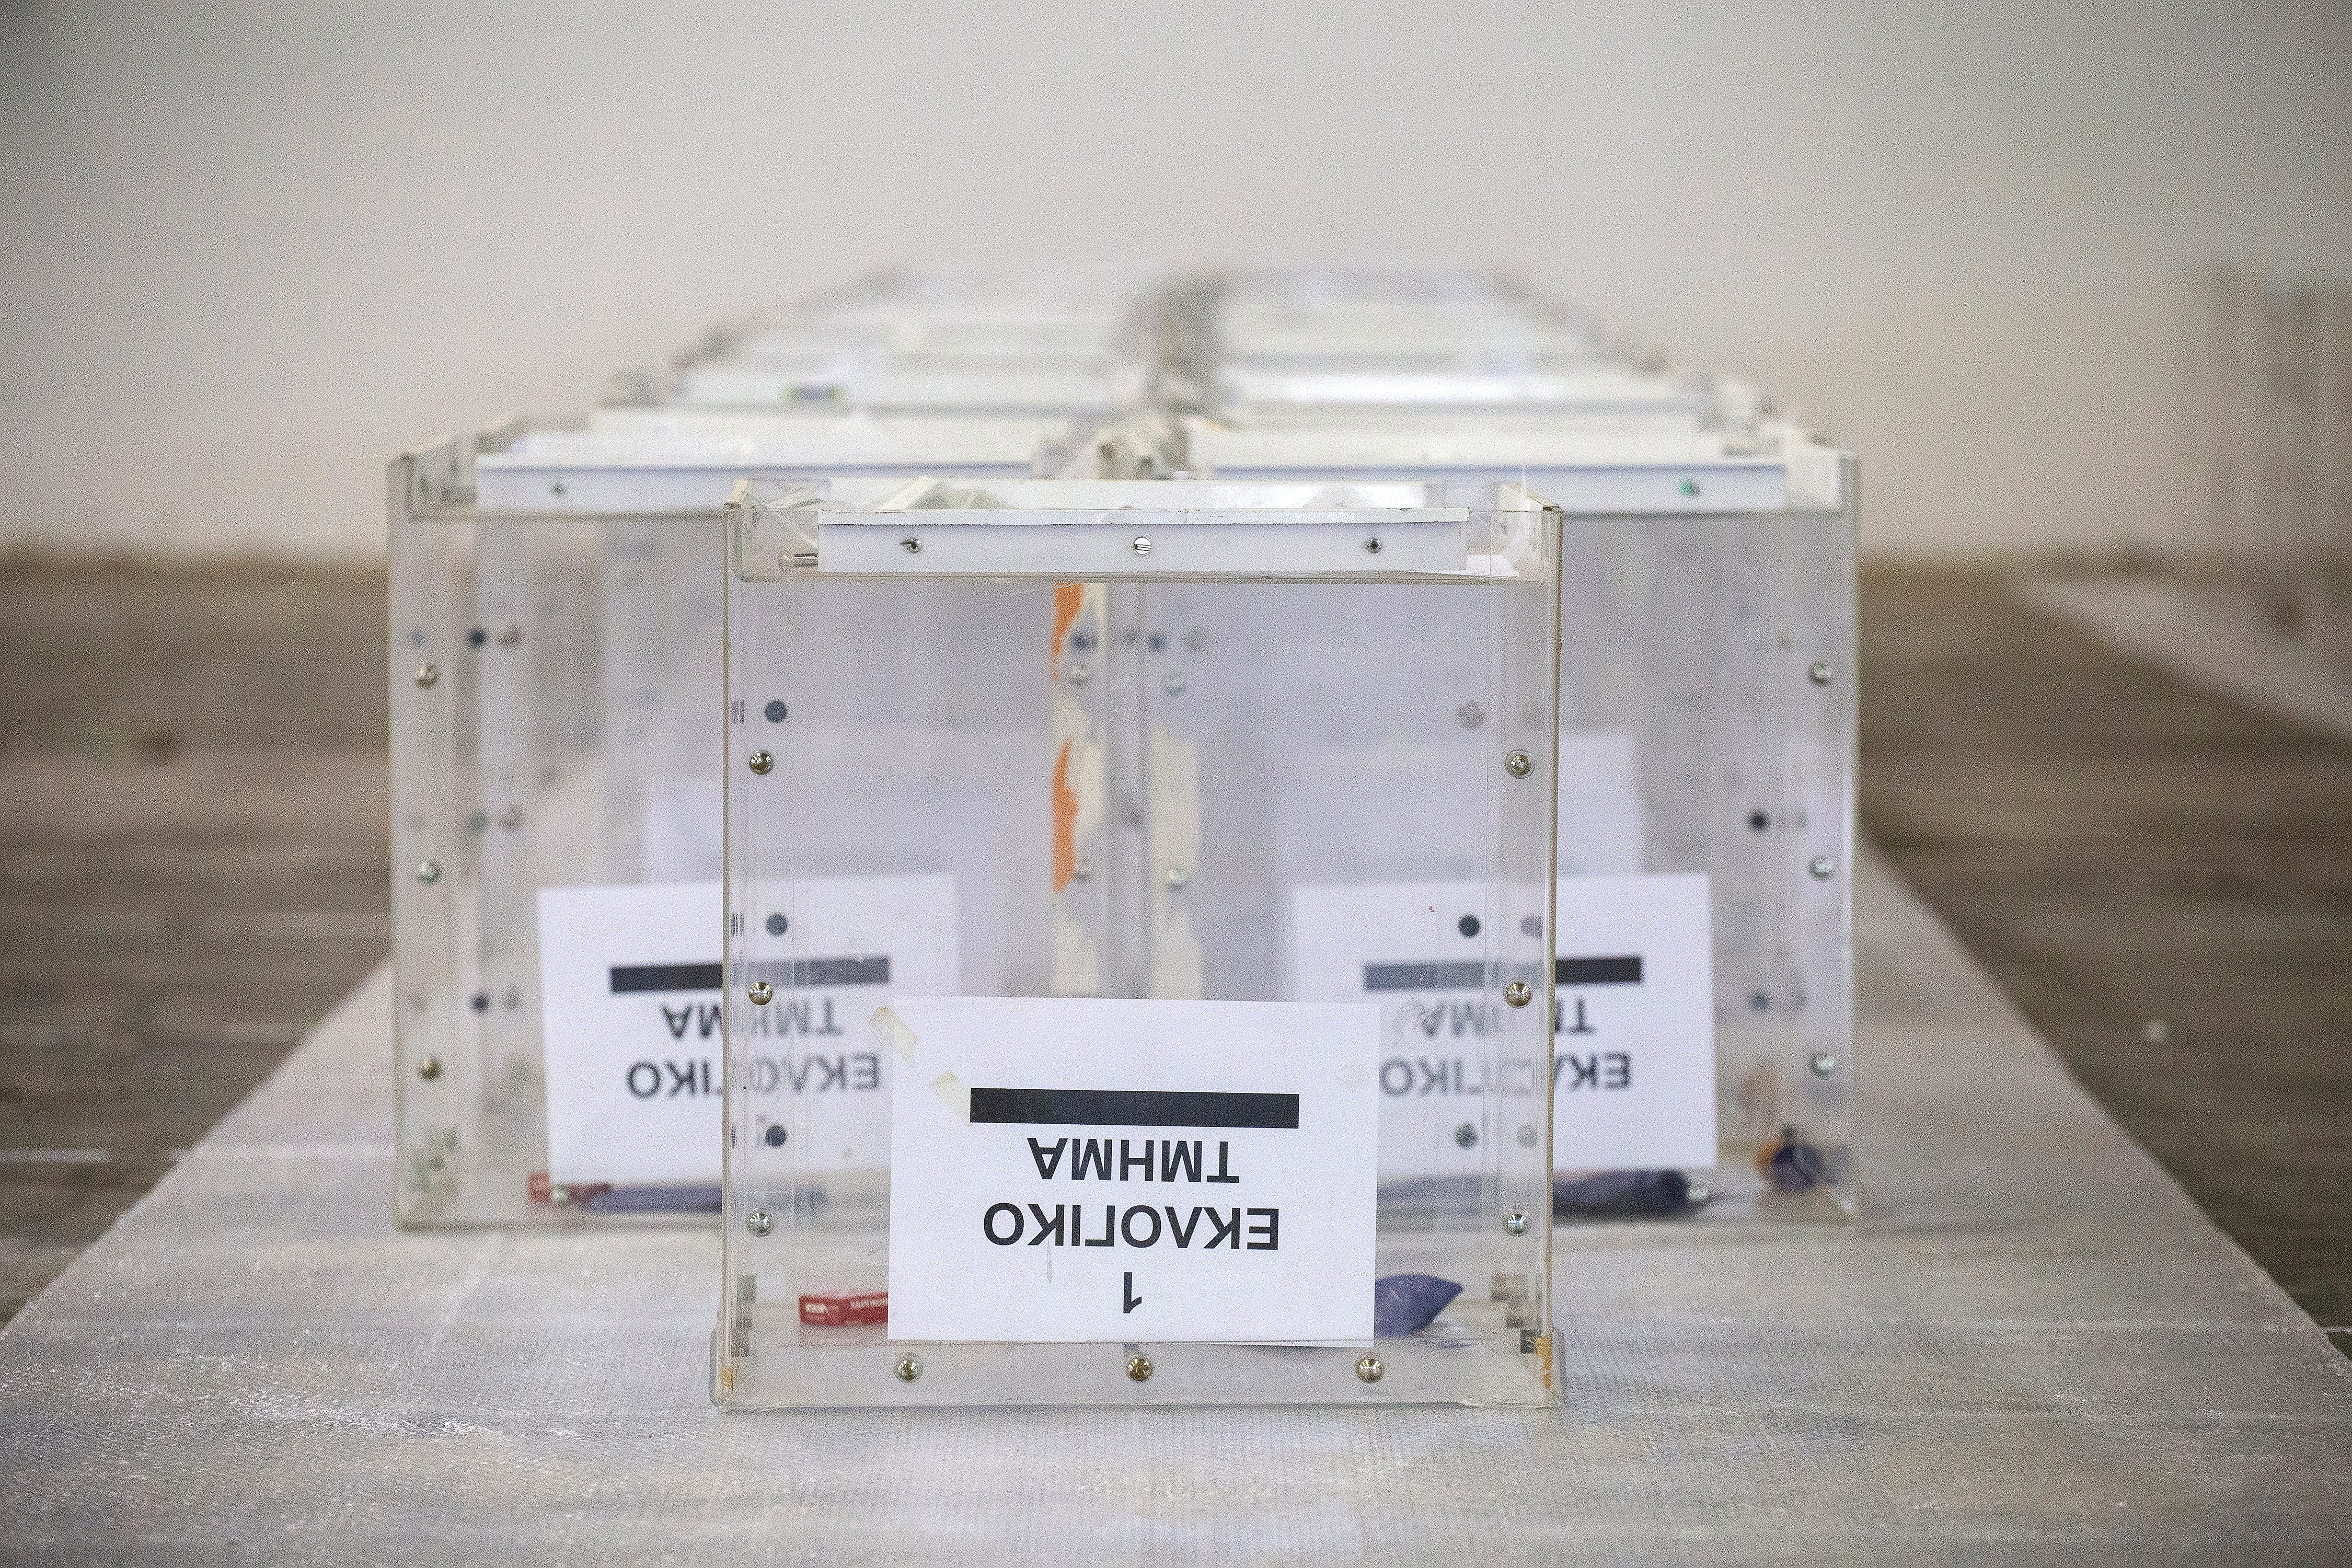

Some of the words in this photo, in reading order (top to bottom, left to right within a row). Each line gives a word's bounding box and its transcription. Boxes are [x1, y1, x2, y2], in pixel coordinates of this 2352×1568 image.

[1420, 999, 1595, 1037] ΤΜΑ
[627, 1053, 880, 1099] ΕΚΛΟΙΚΟ
[1027, 1137, 1240, 1183] ΤΜΗΜΑ
[983, 1202, 1279, 1250] ΕΚΛΟΓΙΚΟ
[1123, 1272, 1142, 1313] 1
